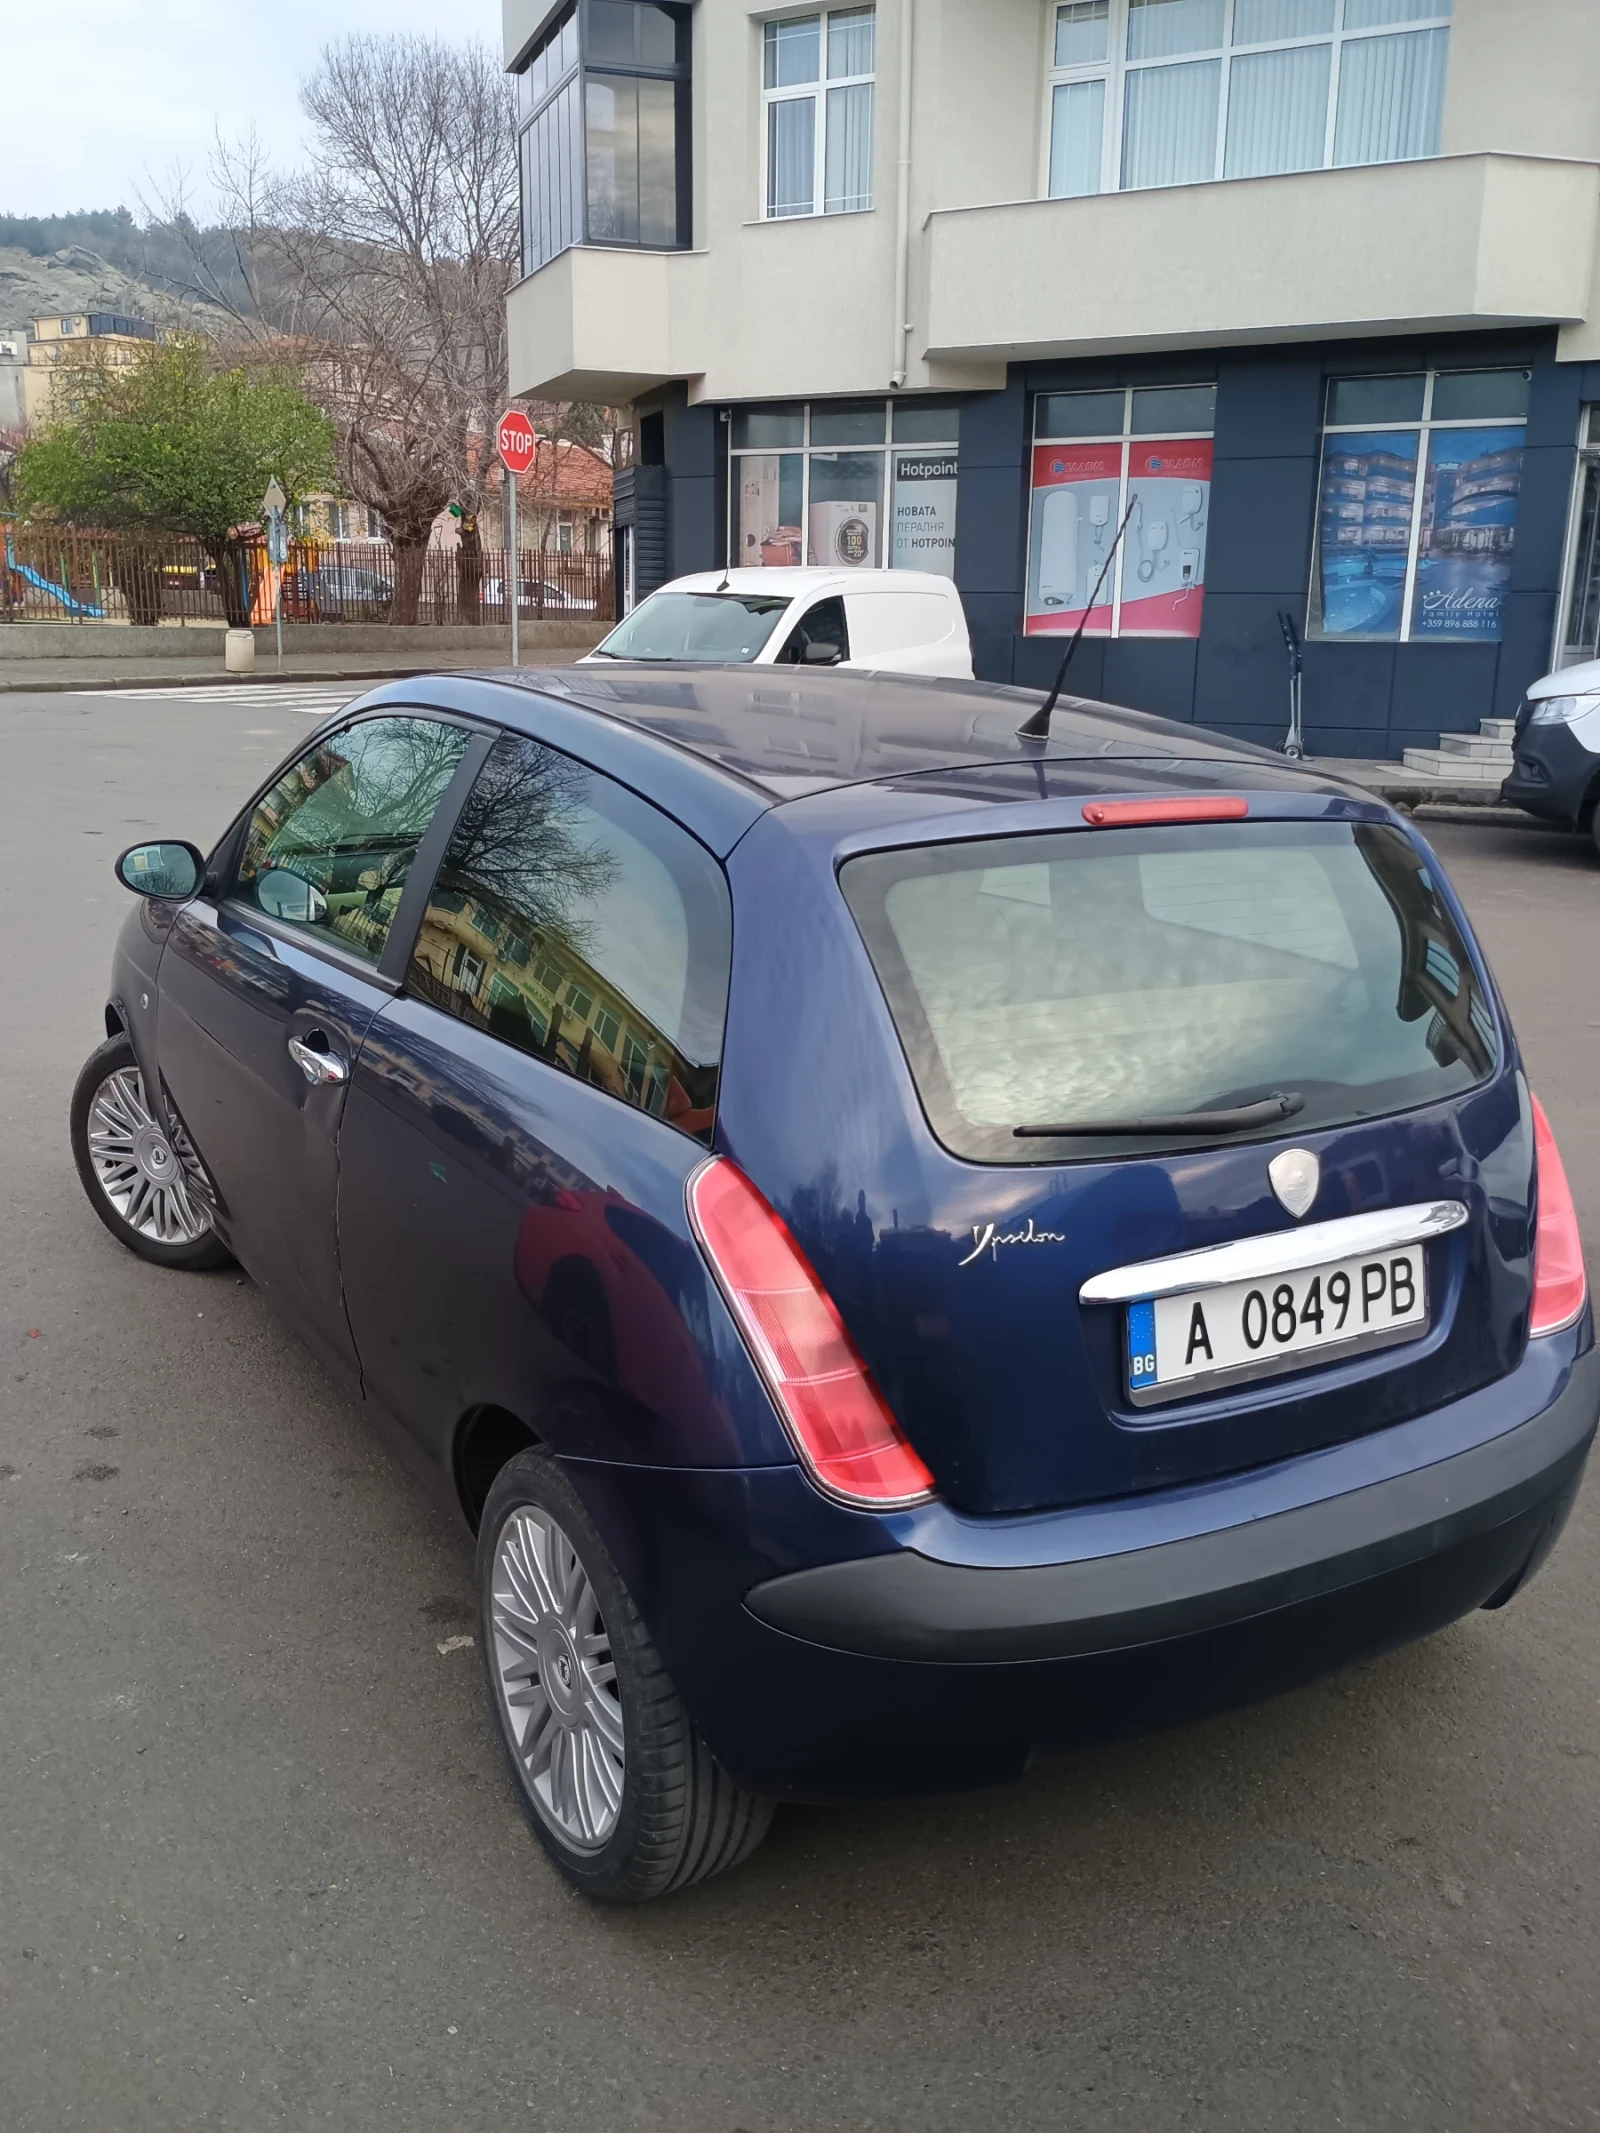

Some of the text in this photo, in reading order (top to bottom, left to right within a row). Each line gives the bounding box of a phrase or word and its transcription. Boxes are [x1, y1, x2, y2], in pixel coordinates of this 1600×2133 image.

[501, 429, 532, 454] STOP
[901, 461, 958, 478] Hotpoint
[897, 506, 936, 516] НОВАТА
[897, 522, 944, 532] ПЕРАЛНЯ
[847, 536, 861, 545] 100
[897, 538, 908, 548] ОТ
[1423, 587, 1500, 609] Adena
[1422, 620, 1496, 628] +359 896 888 116
[957, 1218, 1066, 1266] Ypsilon
[1184, 1301, 1214, 1366] A
[1133, 1354, 1155, 1376] BG
